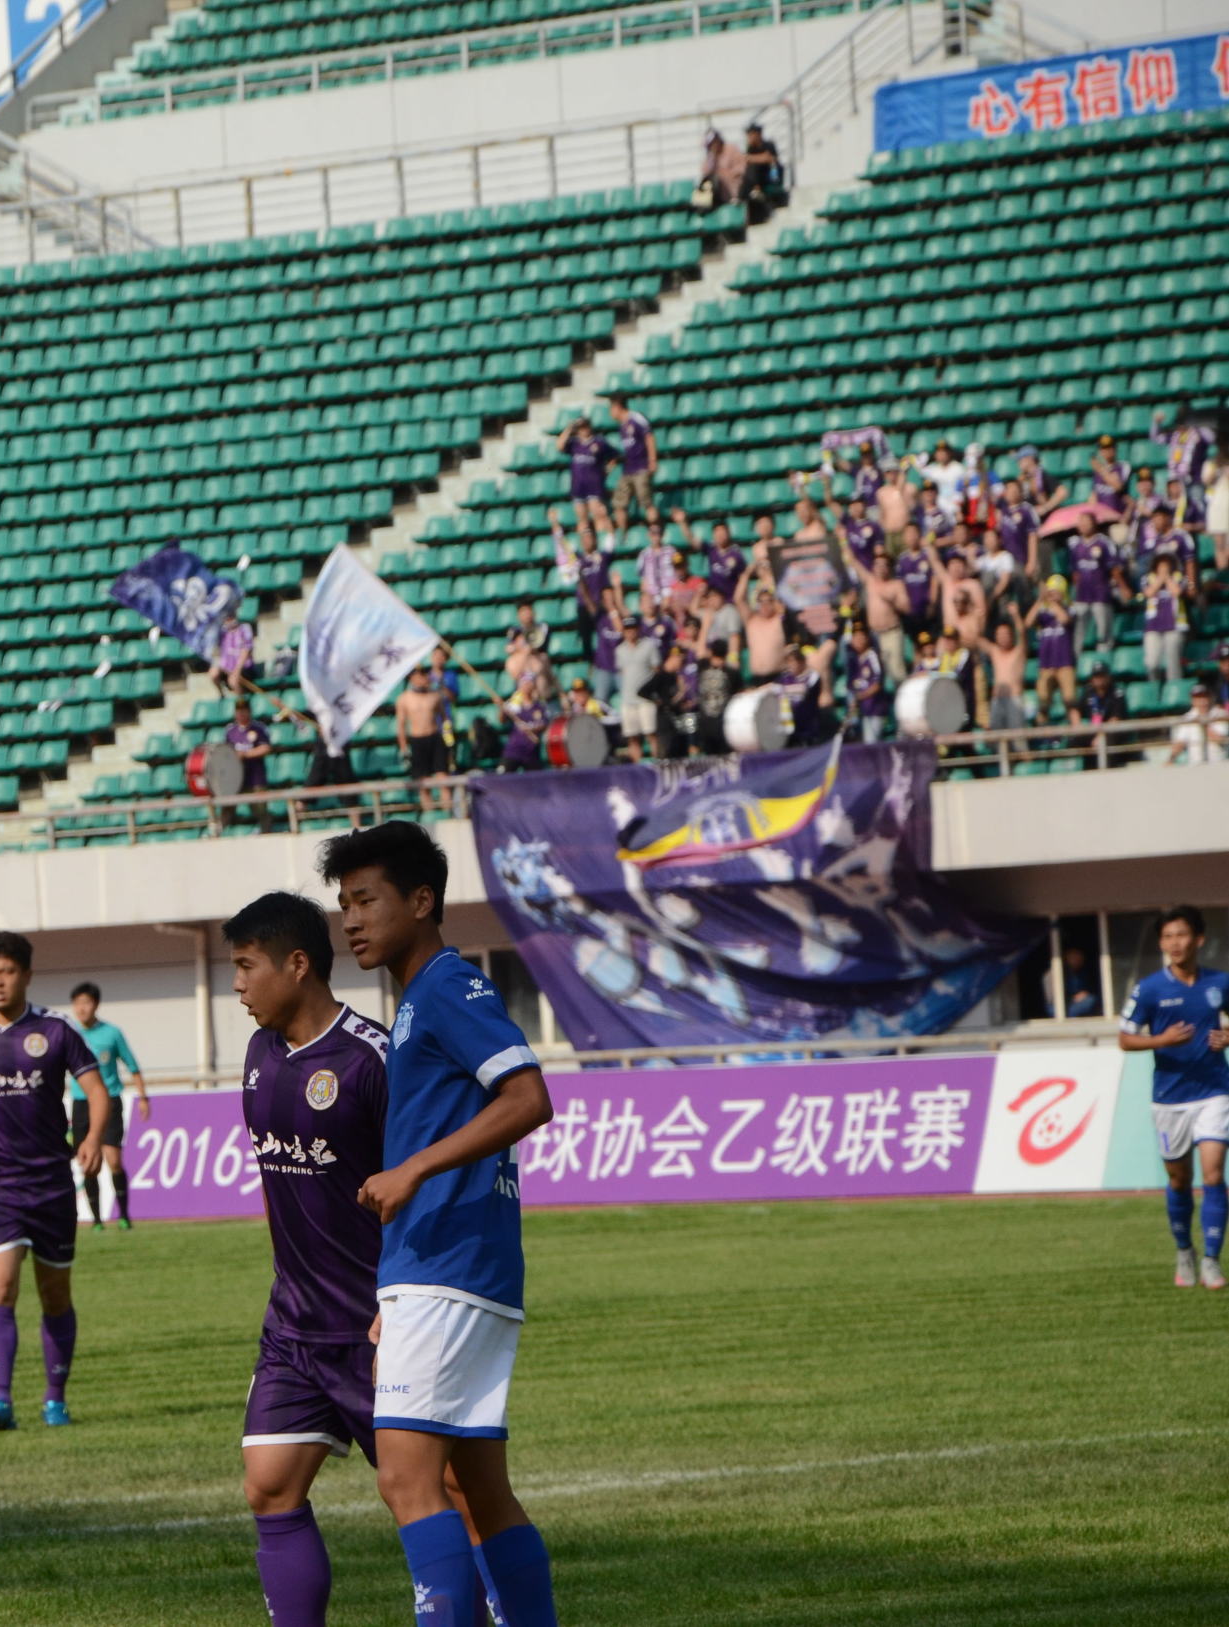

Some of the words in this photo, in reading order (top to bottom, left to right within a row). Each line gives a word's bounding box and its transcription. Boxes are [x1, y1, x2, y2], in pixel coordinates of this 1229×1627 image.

[969, 47, 1178, 138] 心有信仰
[465, 989, 495, 1001] KELME
[524, 1083, 971, 1183] 球协会乙级联赛
[281, 1164, 313, 1176] SPRING
